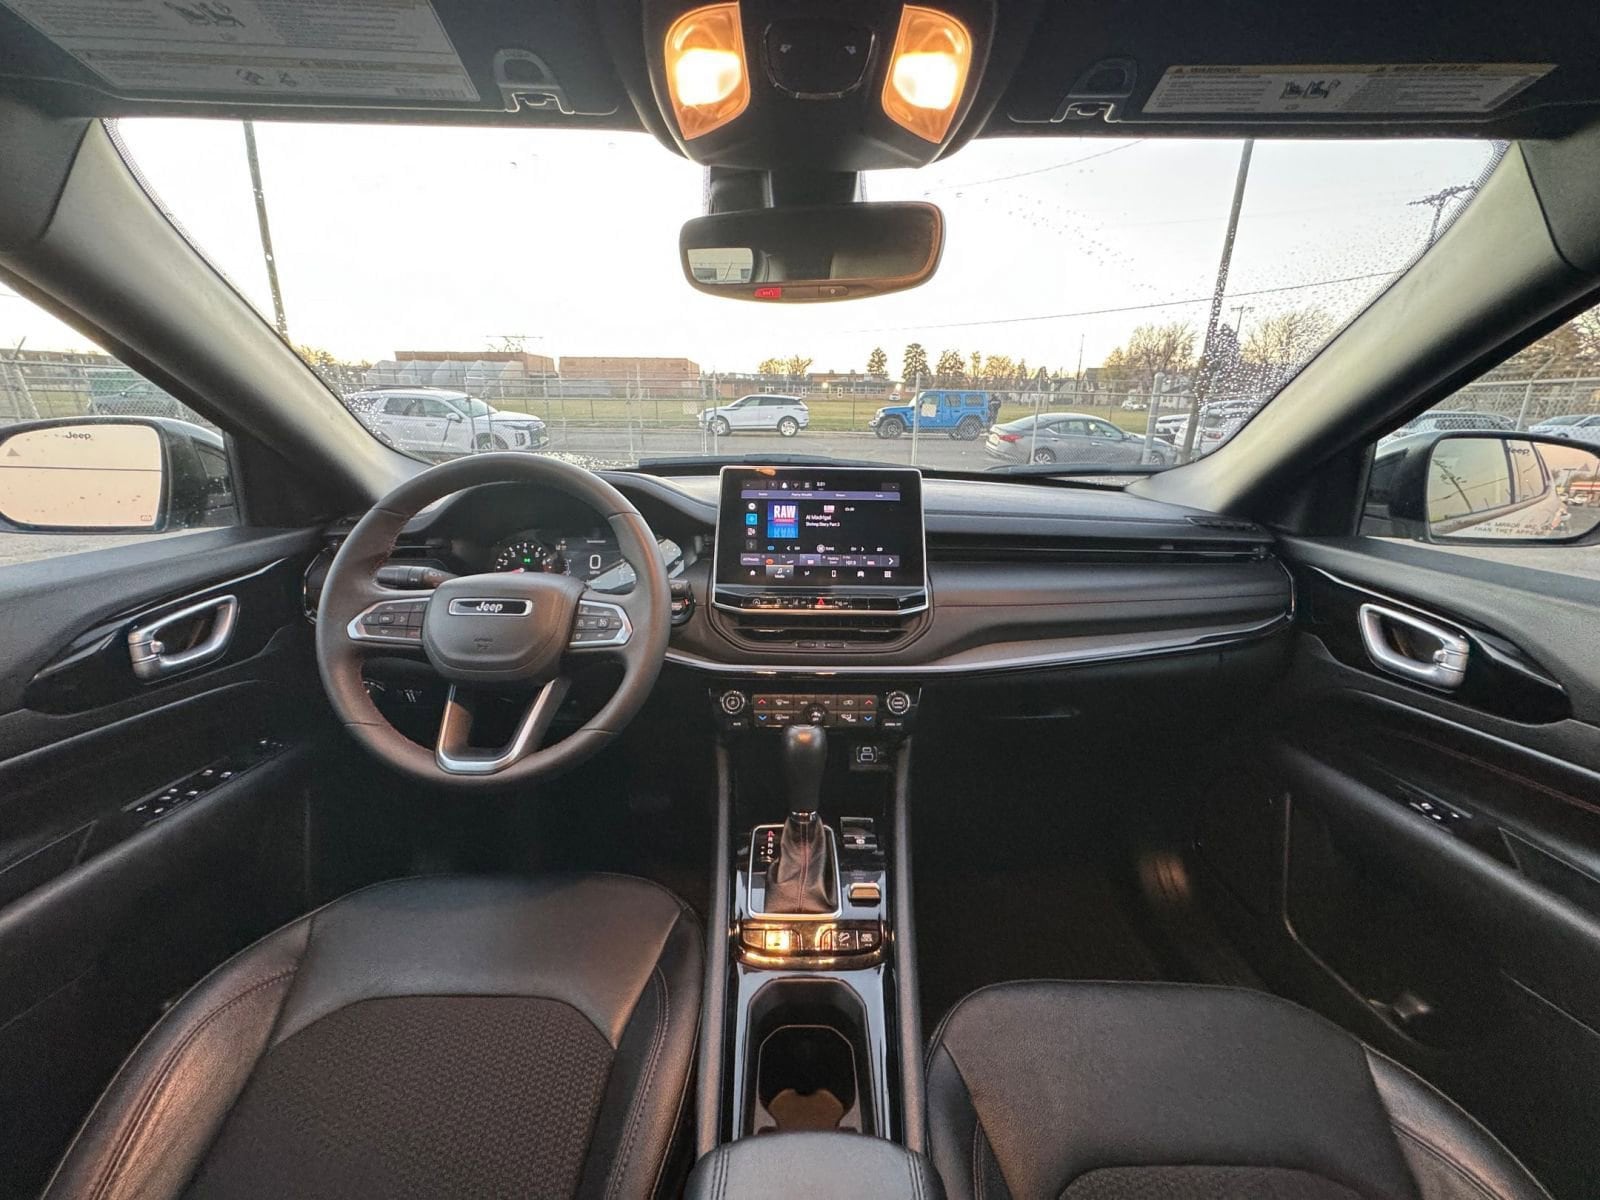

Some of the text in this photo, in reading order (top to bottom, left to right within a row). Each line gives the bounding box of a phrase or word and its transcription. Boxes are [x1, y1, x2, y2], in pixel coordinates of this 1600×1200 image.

[65, 431, 92, 440] Jeep
[774, 505, 796, 518] RAW
[589, 554, 601, 570] 0
[475, 601, 503, 613] Jeep
